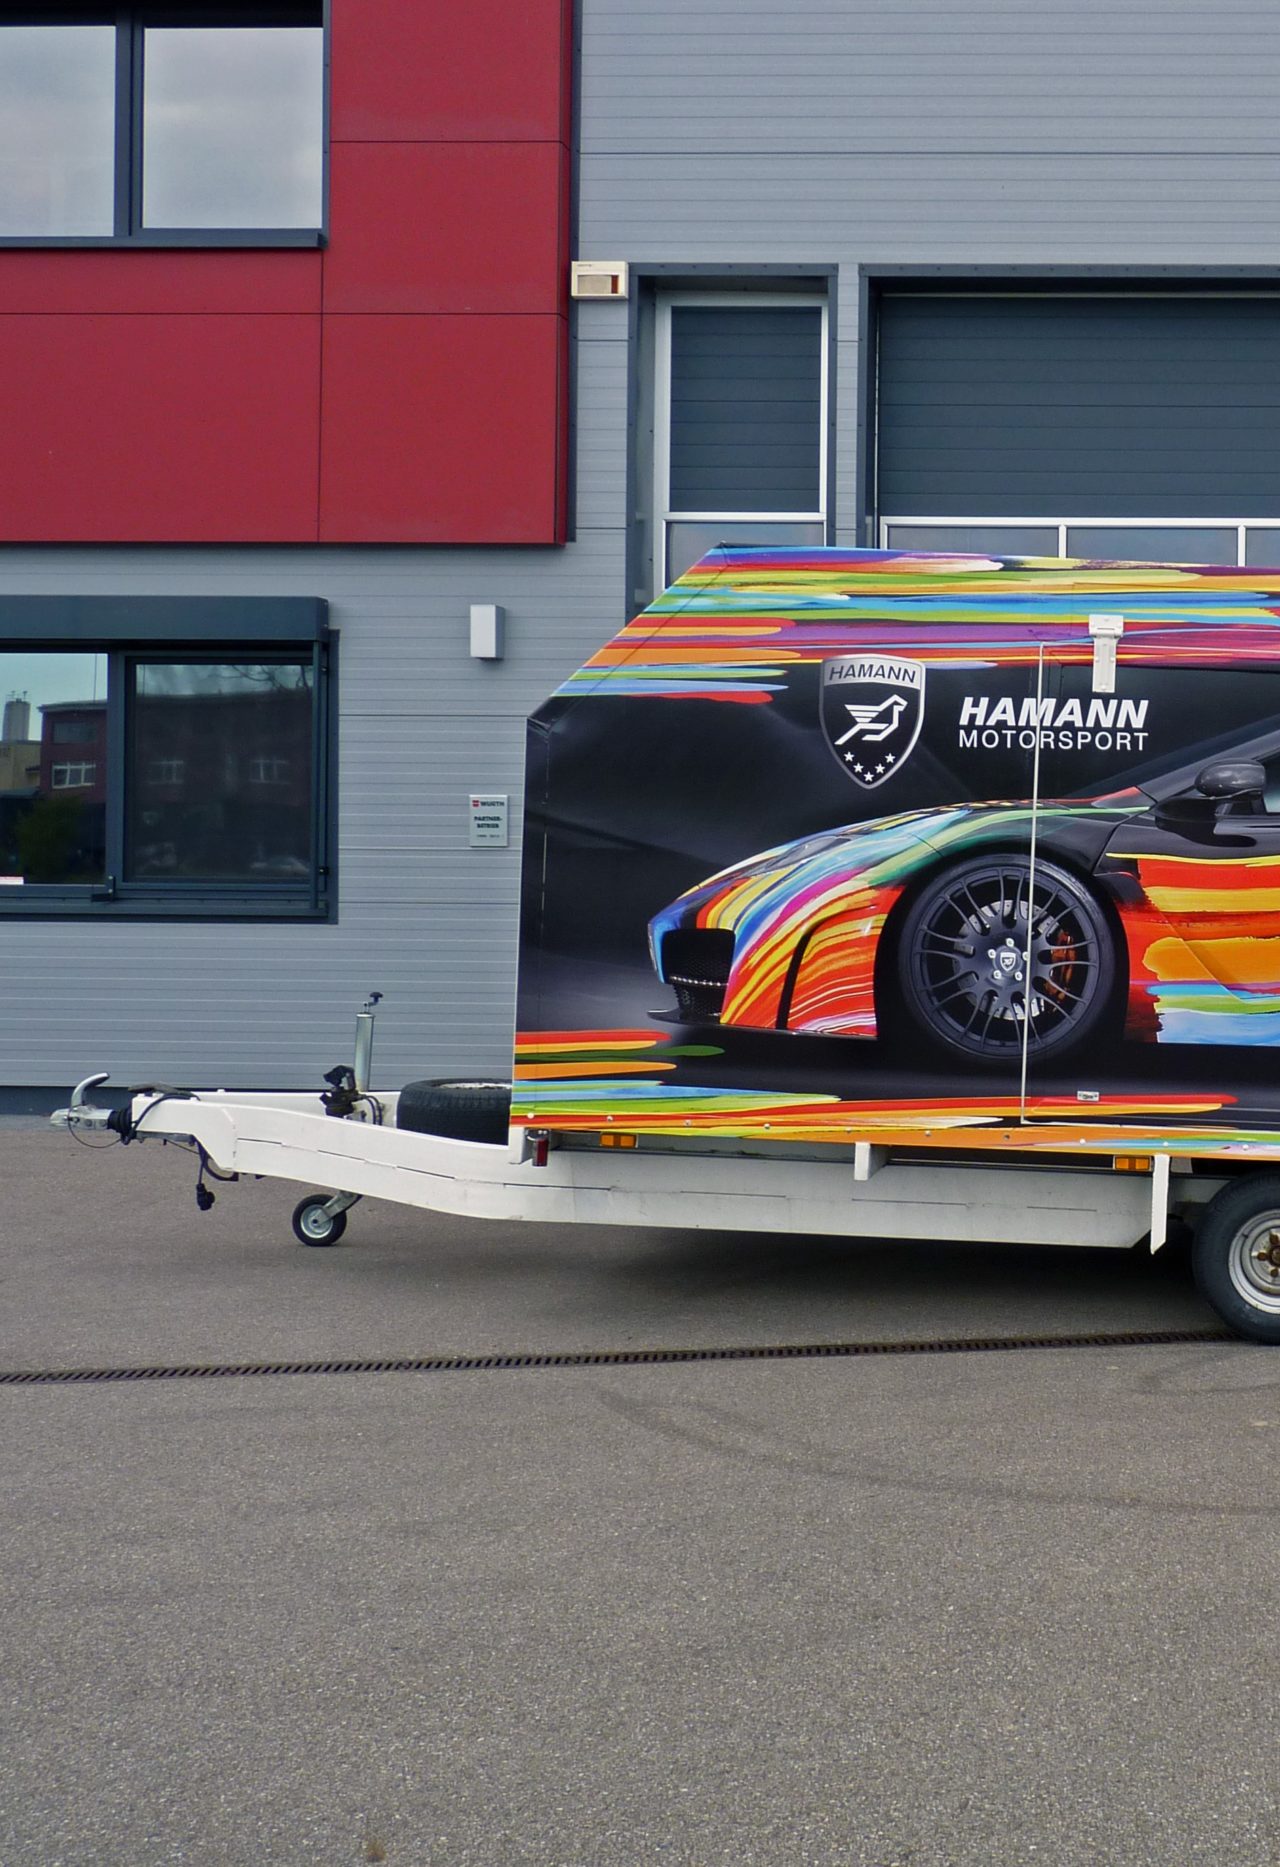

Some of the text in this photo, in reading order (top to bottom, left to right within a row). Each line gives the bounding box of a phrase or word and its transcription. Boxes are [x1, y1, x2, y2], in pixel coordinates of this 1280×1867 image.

[829, 663, 916, 684] HAMANN
[958, 696, 1149, 729] HAMANN
[958, 729, 1149, 751] MOTORSPORT
